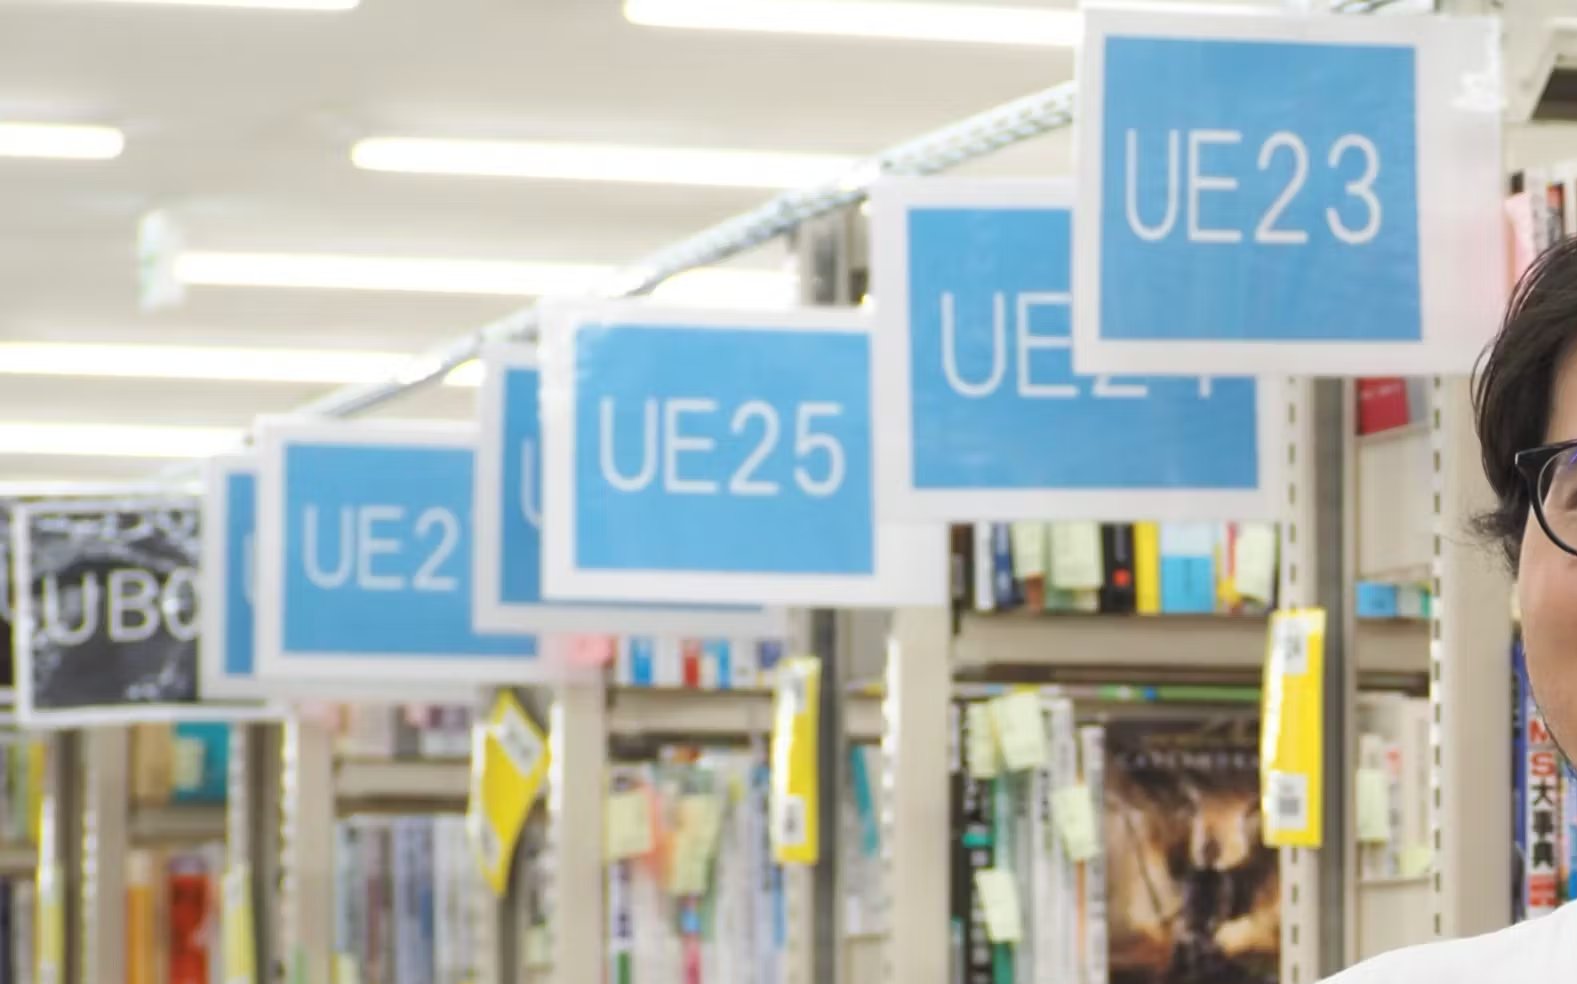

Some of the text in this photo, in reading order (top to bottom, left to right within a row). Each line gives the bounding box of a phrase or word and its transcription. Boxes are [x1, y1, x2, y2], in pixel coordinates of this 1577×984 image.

[1125, 129, 1382, 245] UE23
[941, 291, 1211, 400] UE
[599, 398, 845, 497] UE25
[301, 504, 459, 592] UE2
